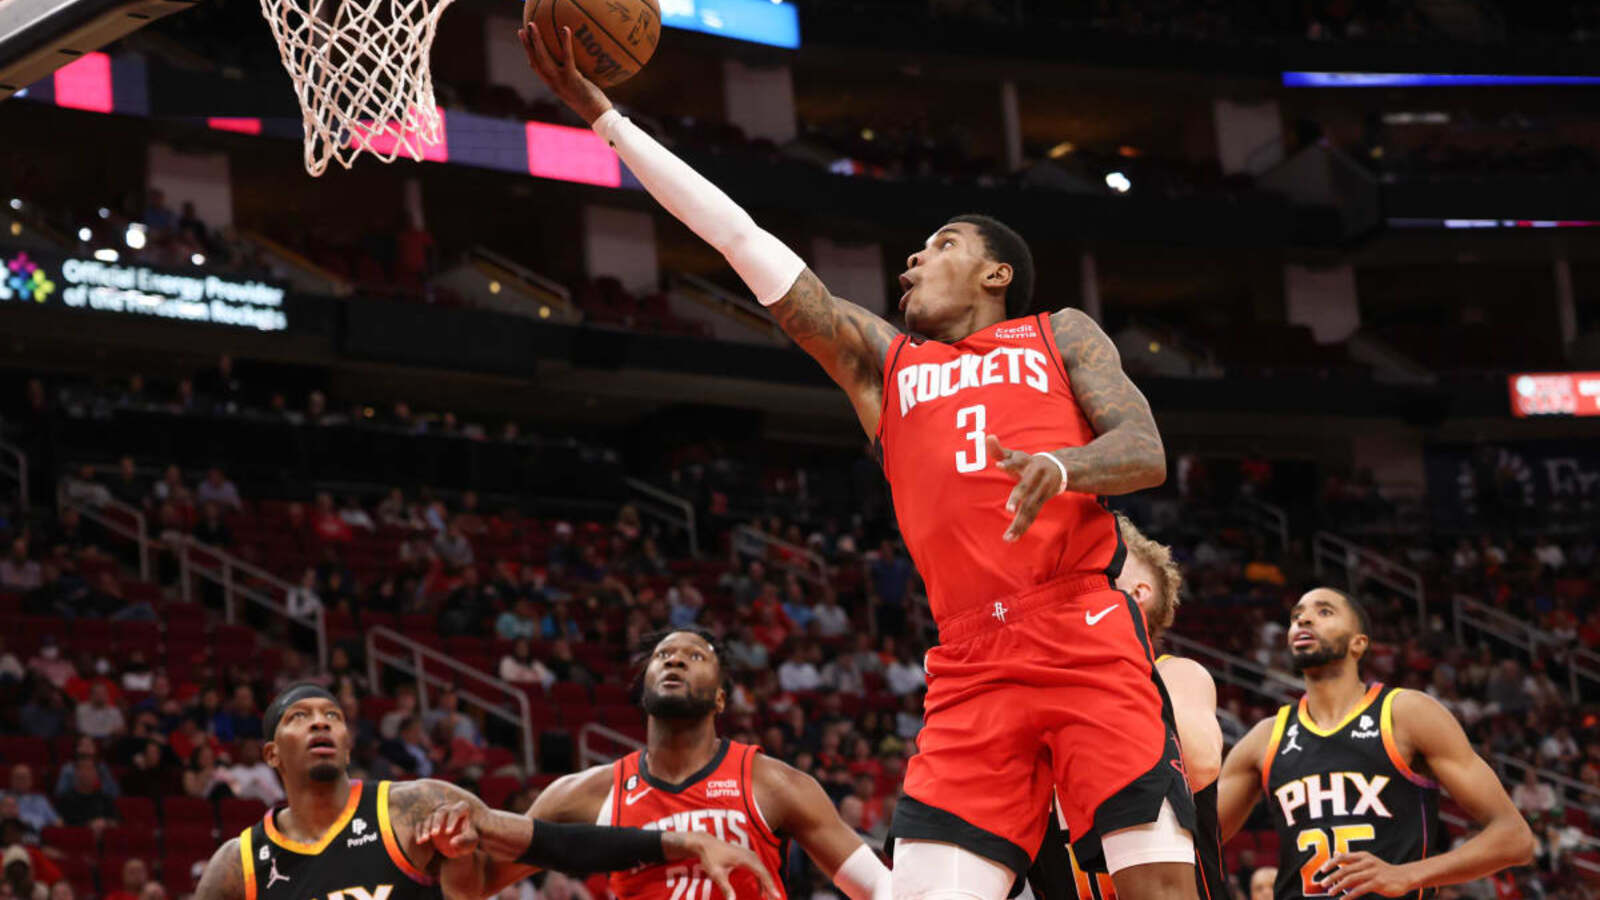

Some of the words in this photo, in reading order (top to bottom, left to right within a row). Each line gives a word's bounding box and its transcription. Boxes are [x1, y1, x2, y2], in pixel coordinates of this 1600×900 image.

[206, 275, 285, 306] Provider
[897, 346, 1049, 418] ROCKETS
[956, 404, 987, 473] 3
[627, 776, 637, 790] 6
[706, 788, 740, 798] karma
[708, 780, 737, 788] credit
[1275, 772, 1393, 827] PHX
[347, 832, 378, 848] PayPal
[642, 809, 749, 849] KETS
[258, 845, 271, 861] 6
